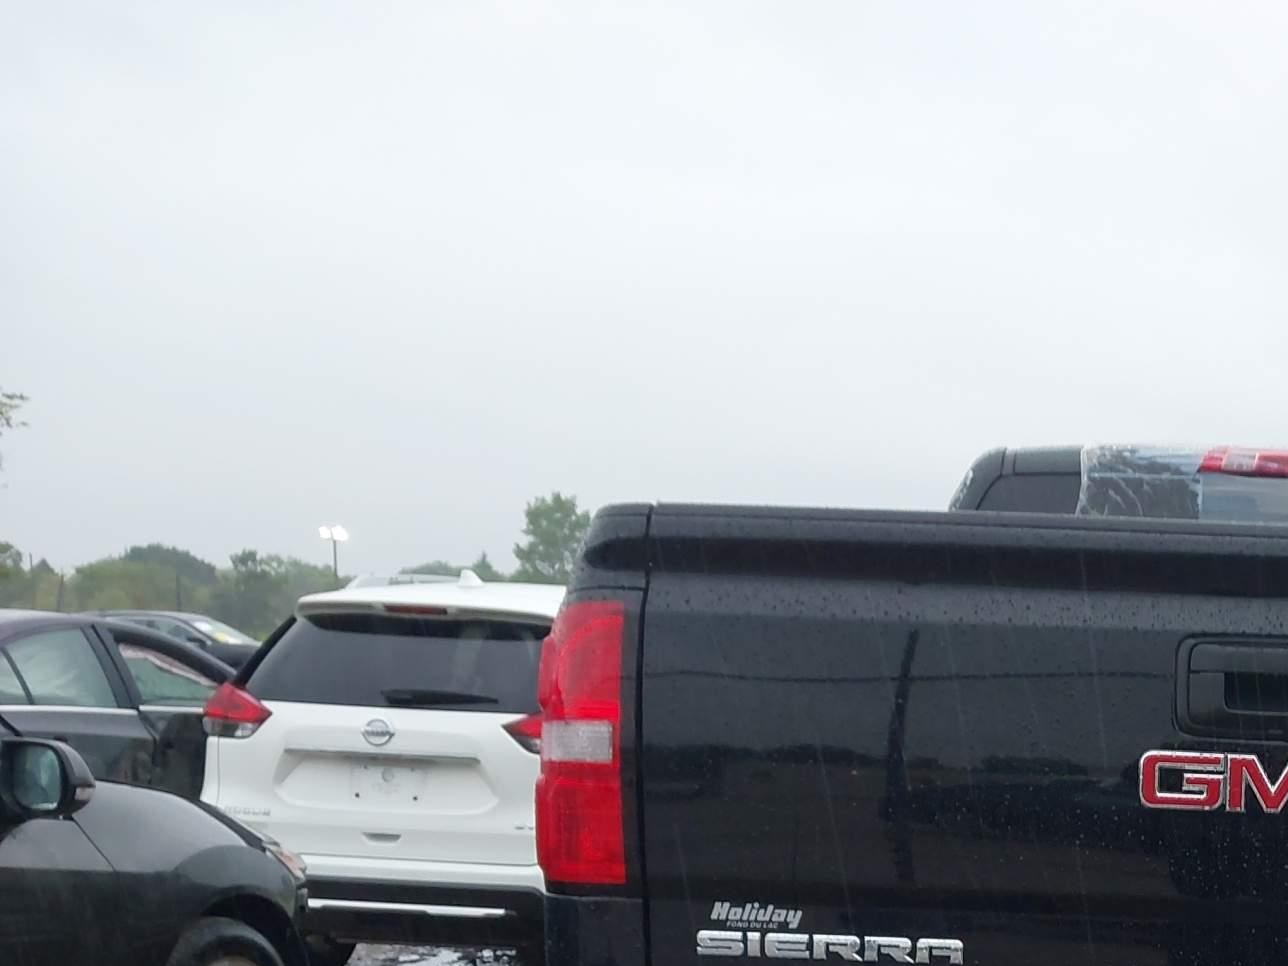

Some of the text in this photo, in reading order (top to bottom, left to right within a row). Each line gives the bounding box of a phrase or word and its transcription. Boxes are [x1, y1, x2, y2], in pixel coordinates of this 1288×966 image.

[710, 901, 803, 929] Holiday
[726, 921, 748, 929] FOND
[697, 930, 963, 965] SIERRA
